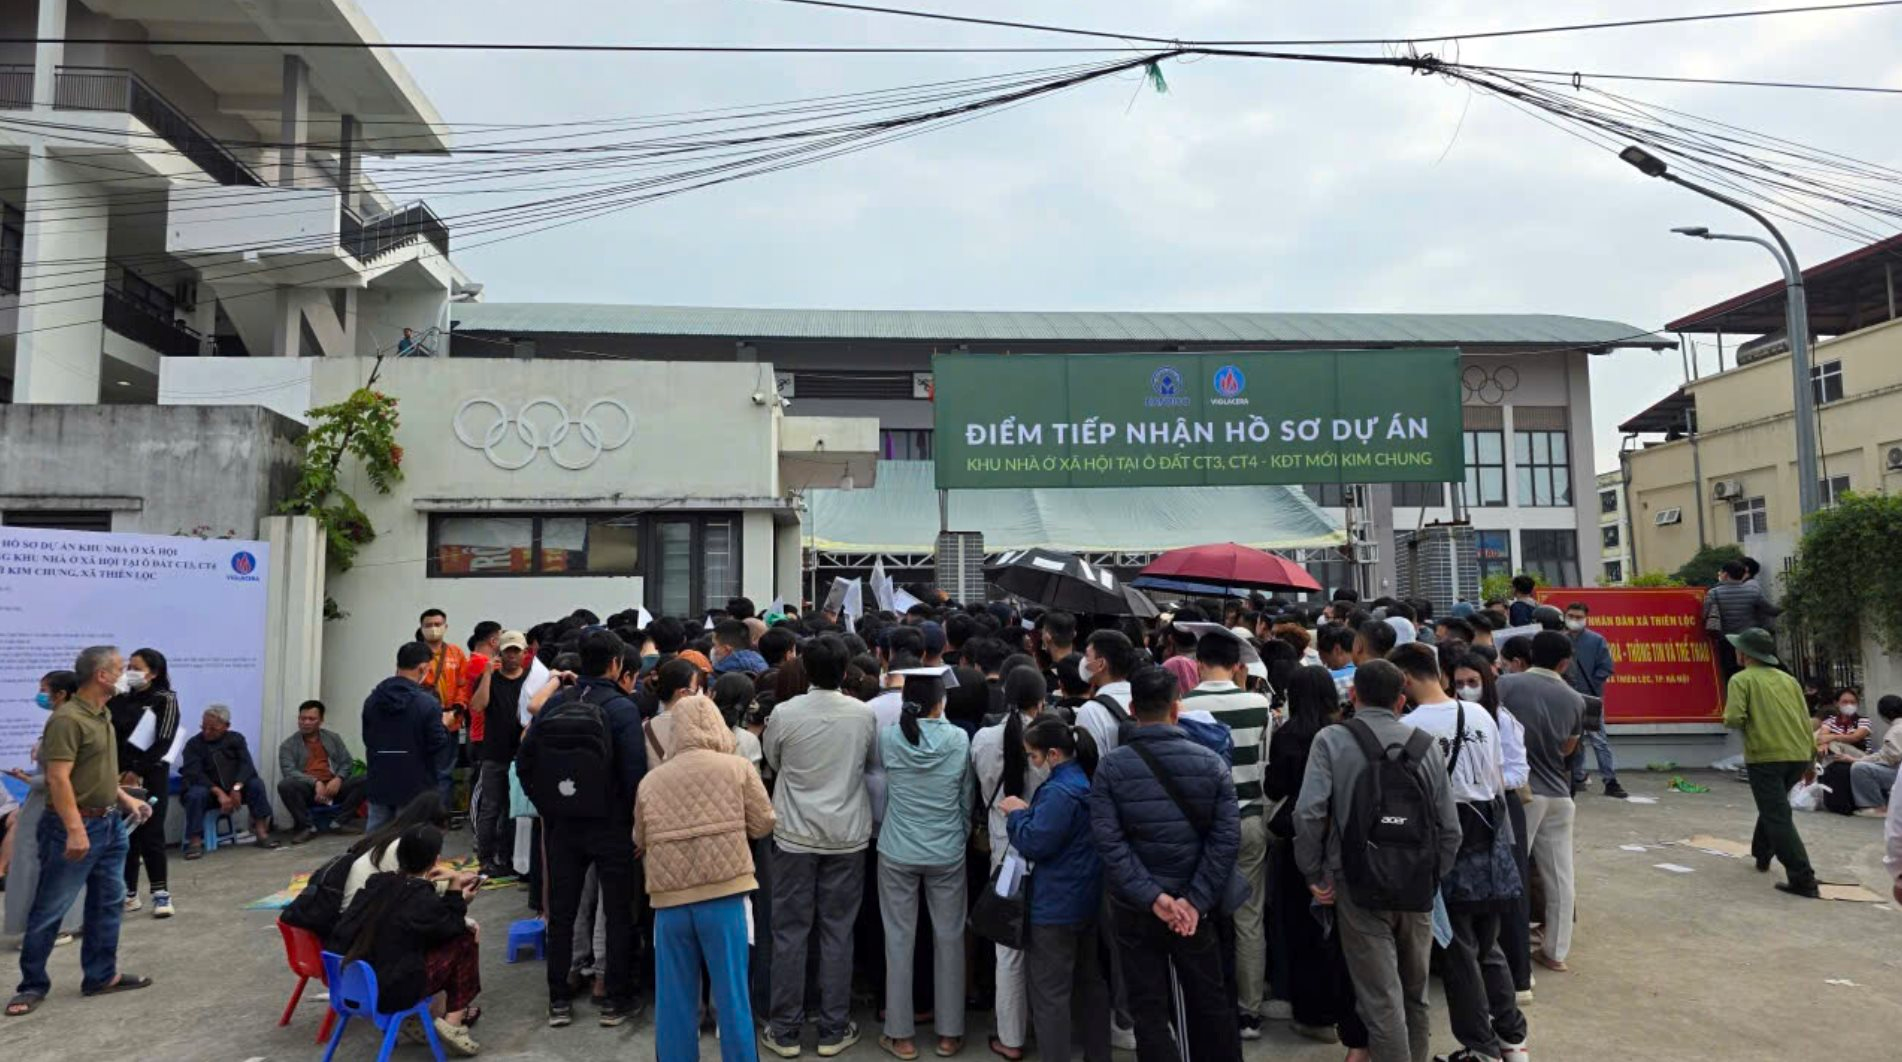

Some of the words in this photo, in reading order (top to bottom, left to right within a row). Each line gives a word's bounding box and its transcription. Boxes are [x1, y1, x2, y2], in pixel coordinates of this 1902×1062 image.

[965, 416, 1042, 445] ĐIỂM
[1052, 416, 1116, 444] TIẾP
[1126, 417, 1214, 448] NHẬN
[1225, 414, 1270, 442] HỒ
[1280, 417, 1321, 442] SƠ
[1332, 416, 1379, 445] DỰ
[1386, 412, 1428, 440] ÁN
[967, 457, 1000, 471] KHU
[1005, 455, 1040, 471] NHÀ
[1059, 454, 1081, 471] XÃ
[1085, 454, 1113, 473] HỘI
[1118, 457, 1139, 473] TẠI
[1143, 453, 1155, 470] Ô
[1159, 451, 1190, 470] ĐẤT
[1193, 456, 1226, 471] CT3,
[1228, 455, 1258, 469] CT4
[1271, 454, 1302, 469] KĐT
[1305, 451, 1338, 467] MỚI
[1341, 453, 1371, 467] KIM
[1374, 452, 1433, 466] CHUNG
[79, 544, 101, 552] KHU
[14, 553, 39, 562] KHU
[8, 566, 32, 575] KIM
[1636, 614, 1649, 626] XÃ
[1679, 613, 1696, 628] LỘC
[1381, 816, 1408, 825] acer
